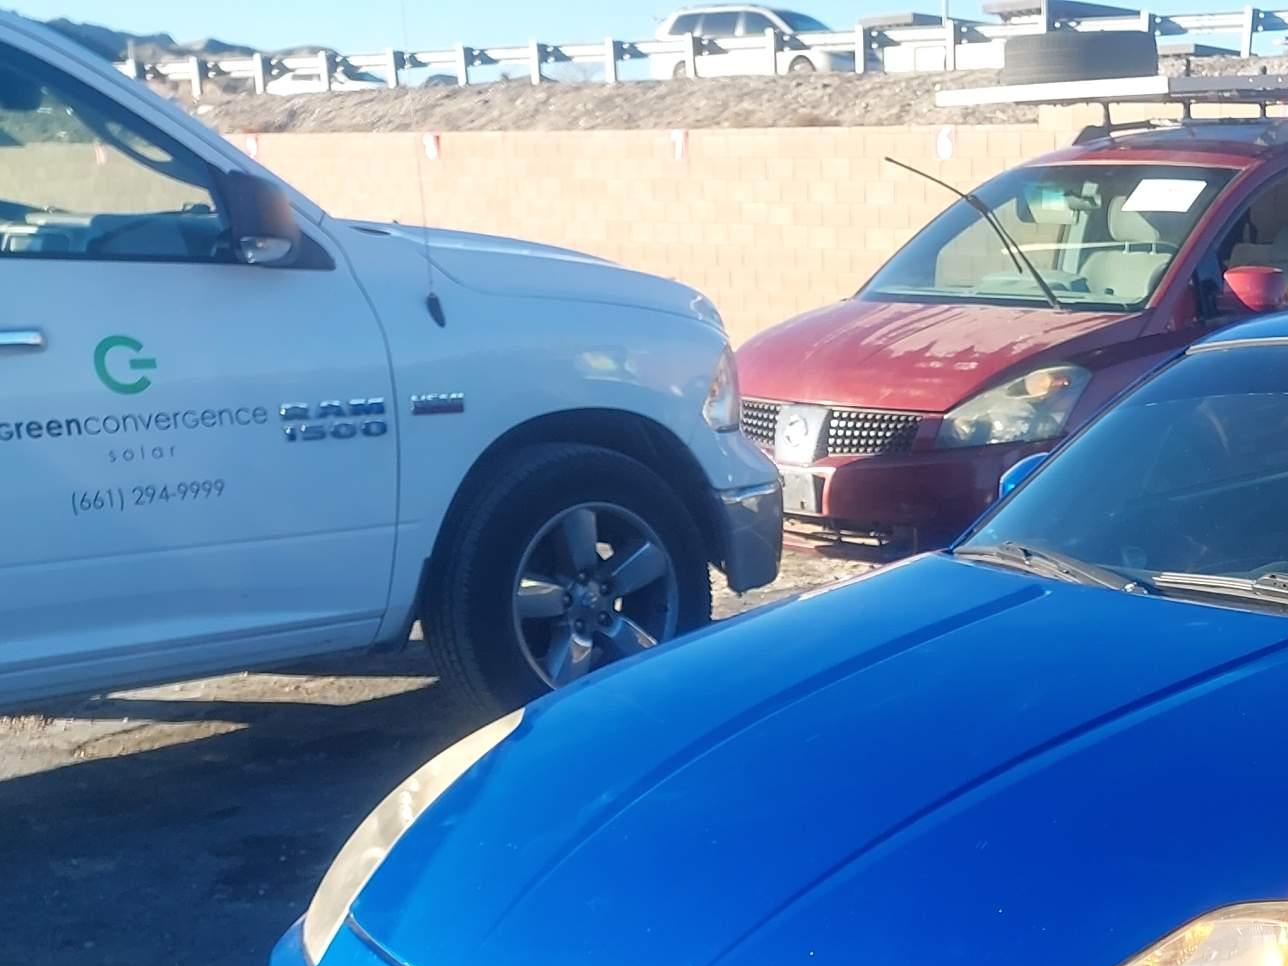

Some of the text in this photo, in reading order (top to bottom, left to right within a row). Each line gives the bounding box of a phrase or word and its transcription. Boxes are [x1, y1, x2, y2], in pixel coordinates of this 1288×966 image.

[279, 397, 385, 422] RAM
[284, 420, 388, 442] 1500
[108, 445, 176, 463] solar
[71, 478, 226, 516] (661) 294-9999
